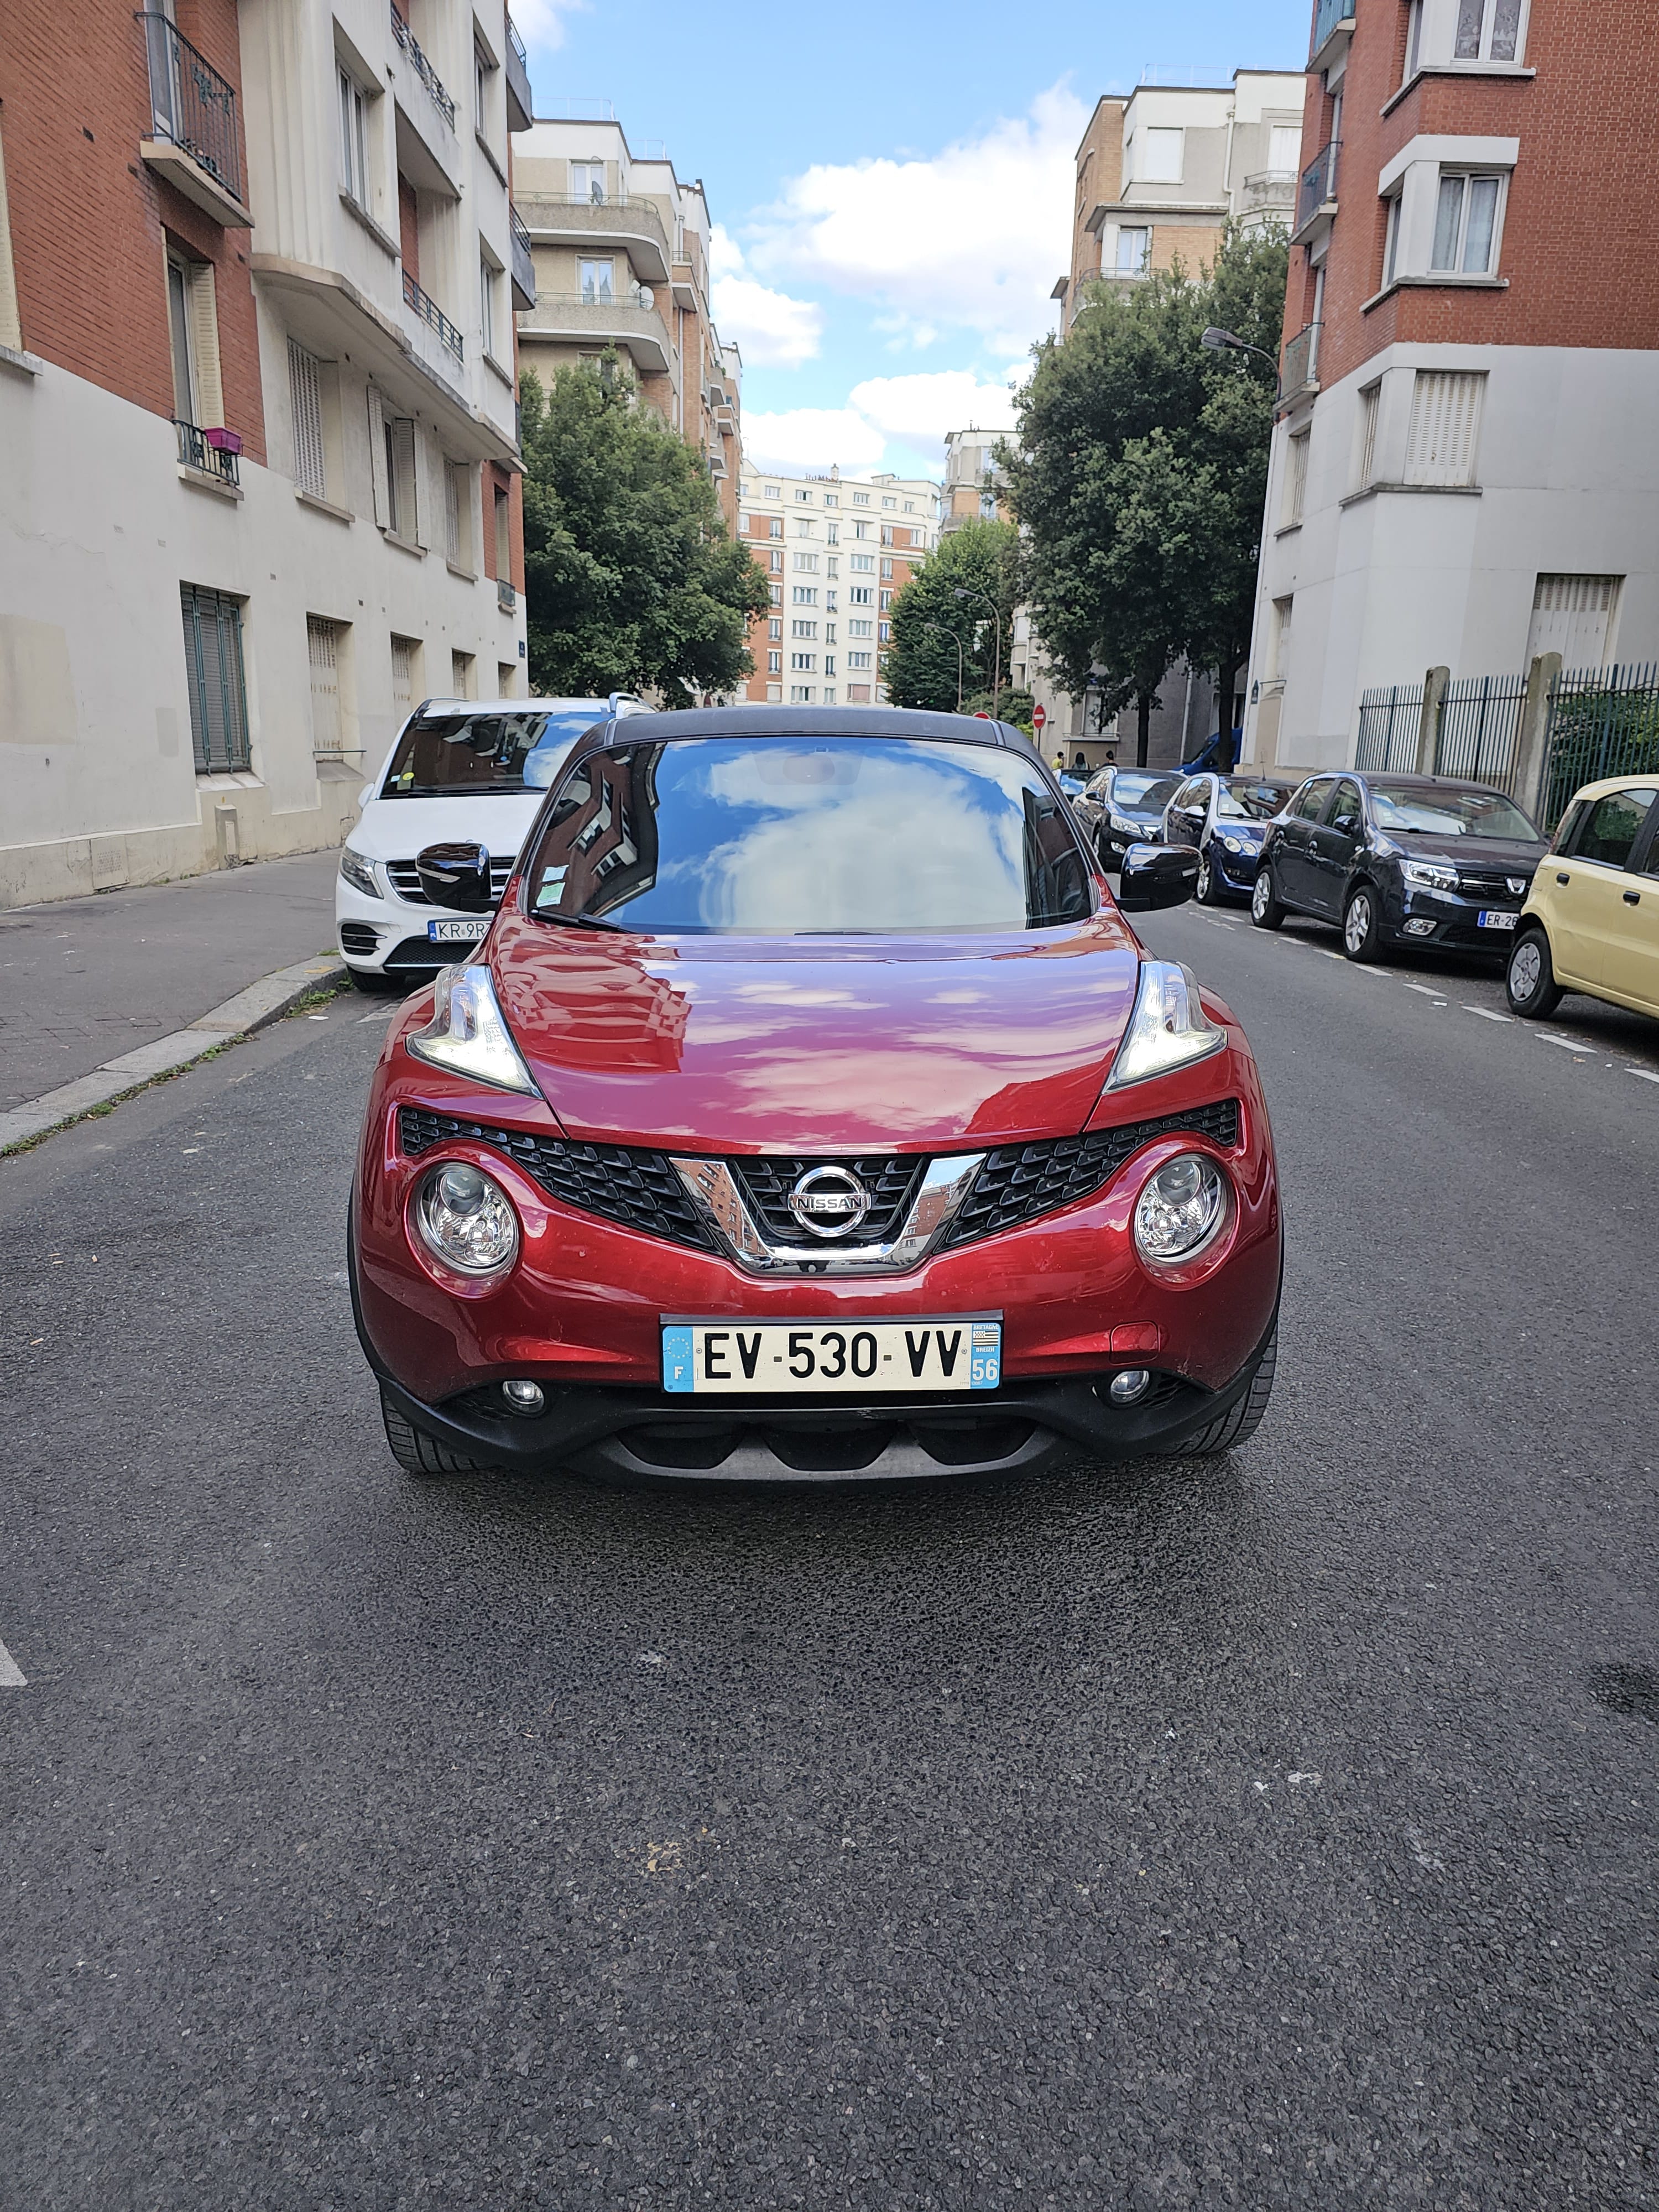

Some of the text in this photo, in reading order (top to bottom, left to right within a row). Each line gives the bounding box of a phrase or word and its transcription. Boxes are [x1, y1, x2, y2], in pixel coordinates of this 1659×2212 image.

[439, 923, 491, 938] KR 9R
[797, 1197, 863, 1209] NISSAN
[674, 1366, 684, 1379] F
[972, 1358, 998, 1381] 56
